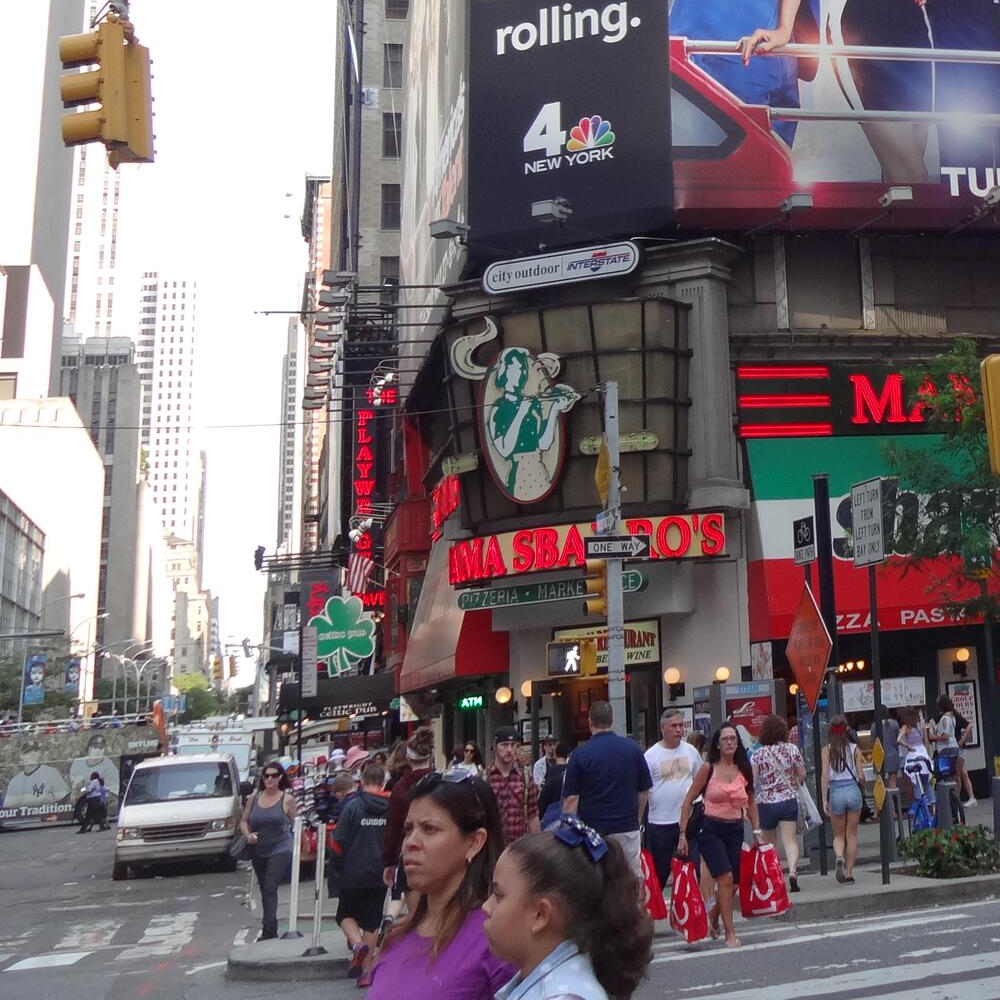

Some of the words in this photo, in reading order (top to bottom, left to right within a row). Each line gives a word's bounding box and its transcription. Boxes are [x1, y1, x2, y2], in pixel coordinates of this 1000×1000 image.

[496, 1, 641, 56] rolling.
[523, 101, 567, 157] 4
[524, 157, 561, 175] NEW
[564, 146, 614, 167] YORK
[492, 269, 513, 284] city
[515, 263, 561, 280] outdoor
[567, 252, 631, 272] INTERSTATE
[853, 492, 866, 507] LEFT
[860, 508, 874, 521] FROM
[855, 526, 867, 540] LEFT
[512, 513, 726, 572] SBARO'S
[593, 542, 613, 552] ONE
[620, 541, 641, 552] WAY
[461, 588, 519, 608] PIZZERIA
[626, 650, 651, 661] WINE
[461, 695, 483, 708] ATM
[20, 803, 76, 816] Tradition.
